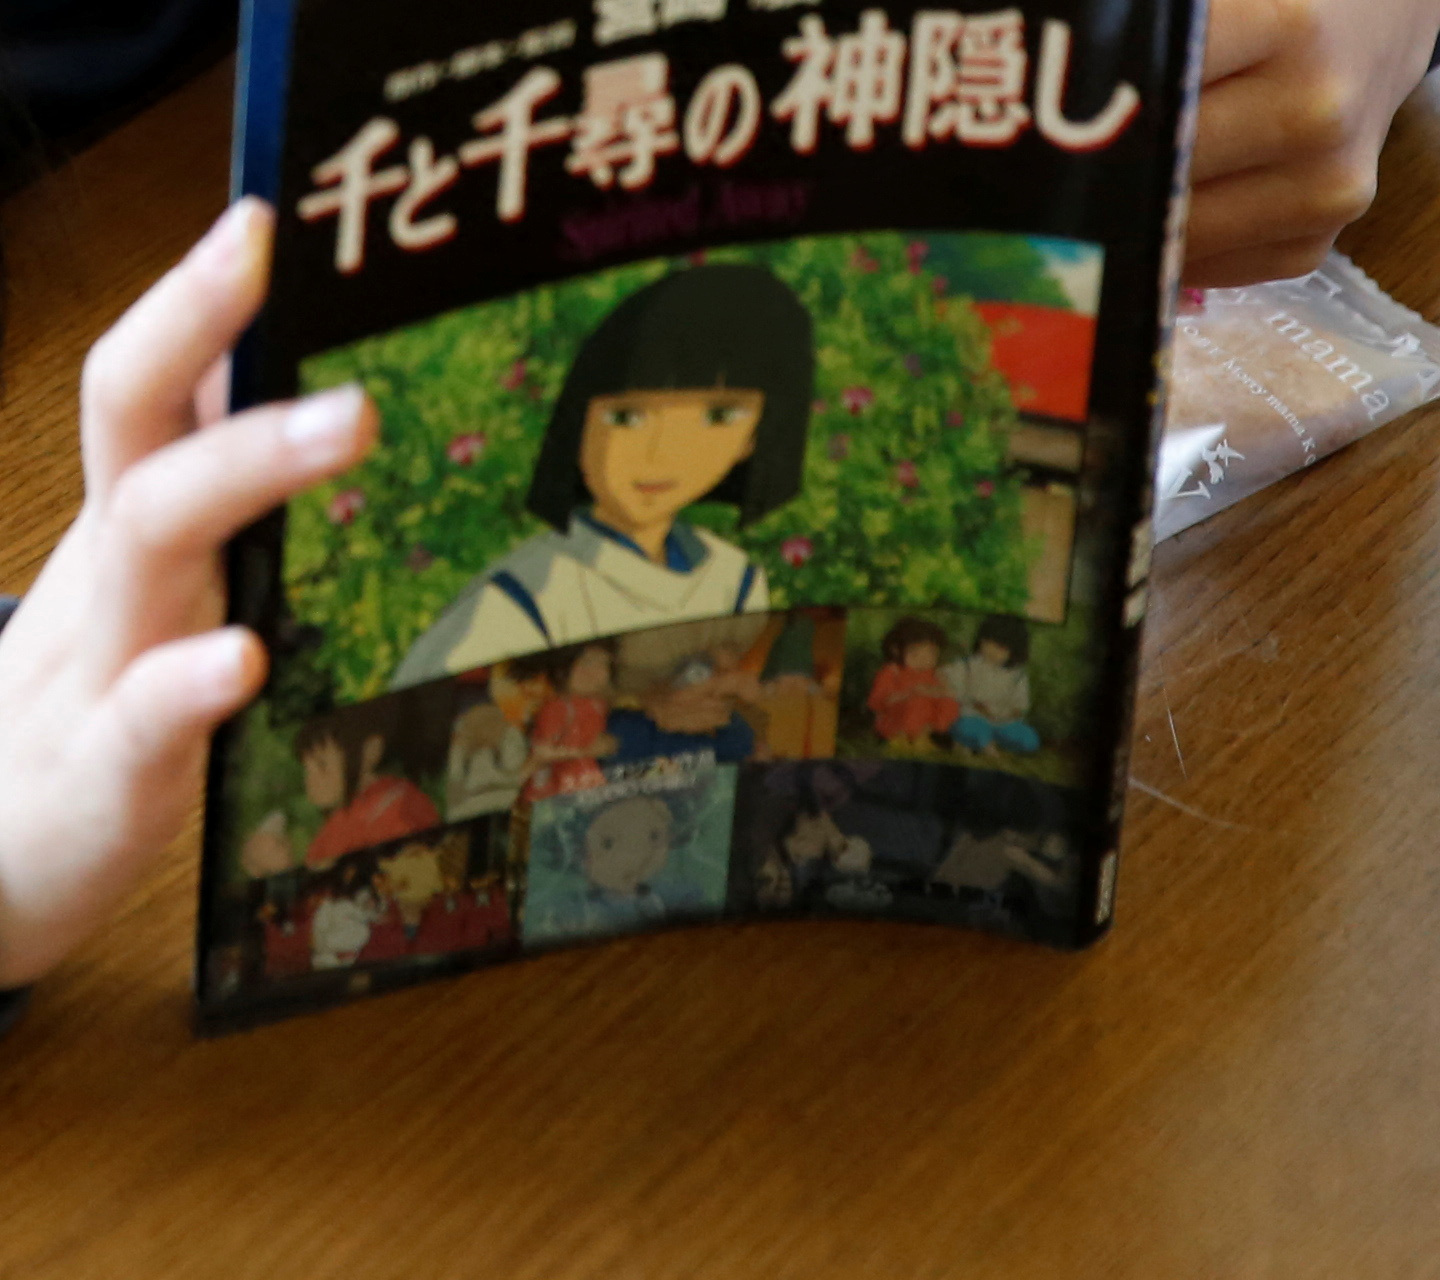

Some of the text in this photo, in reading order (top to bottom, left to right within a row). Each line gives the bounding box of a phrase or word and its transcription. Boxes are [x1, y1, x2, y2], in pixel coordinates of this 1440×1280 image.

[297, 8, 1141, 273] 千と千尋の神隠し
